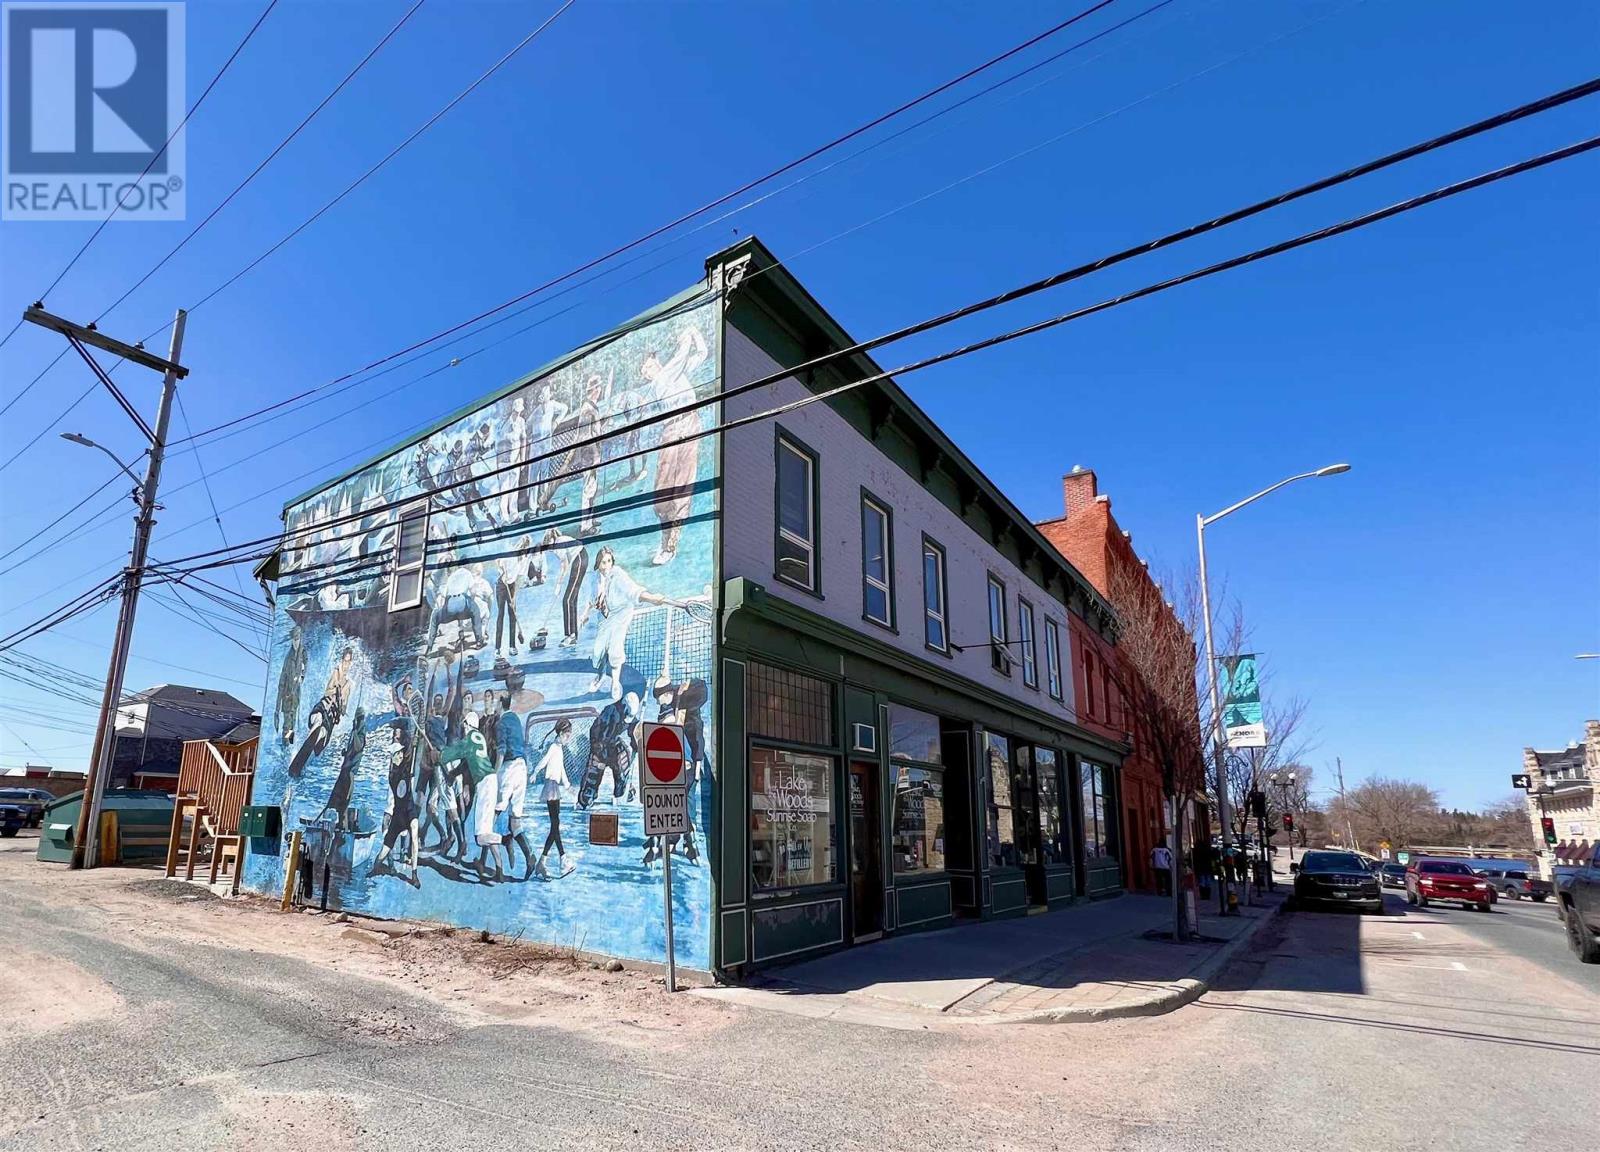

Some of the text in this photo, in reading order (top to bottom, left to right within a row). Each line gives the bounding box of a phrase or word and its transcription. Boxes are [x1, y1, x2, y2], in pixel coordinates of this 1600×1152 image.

[470, 731, 488, 758] 9
[779, 764, 806, 791] Lake
[776, 788, 813, 809] Woods
[650, 813, 683, 829] ENTER
[797, 809, 818, 823] Soap
